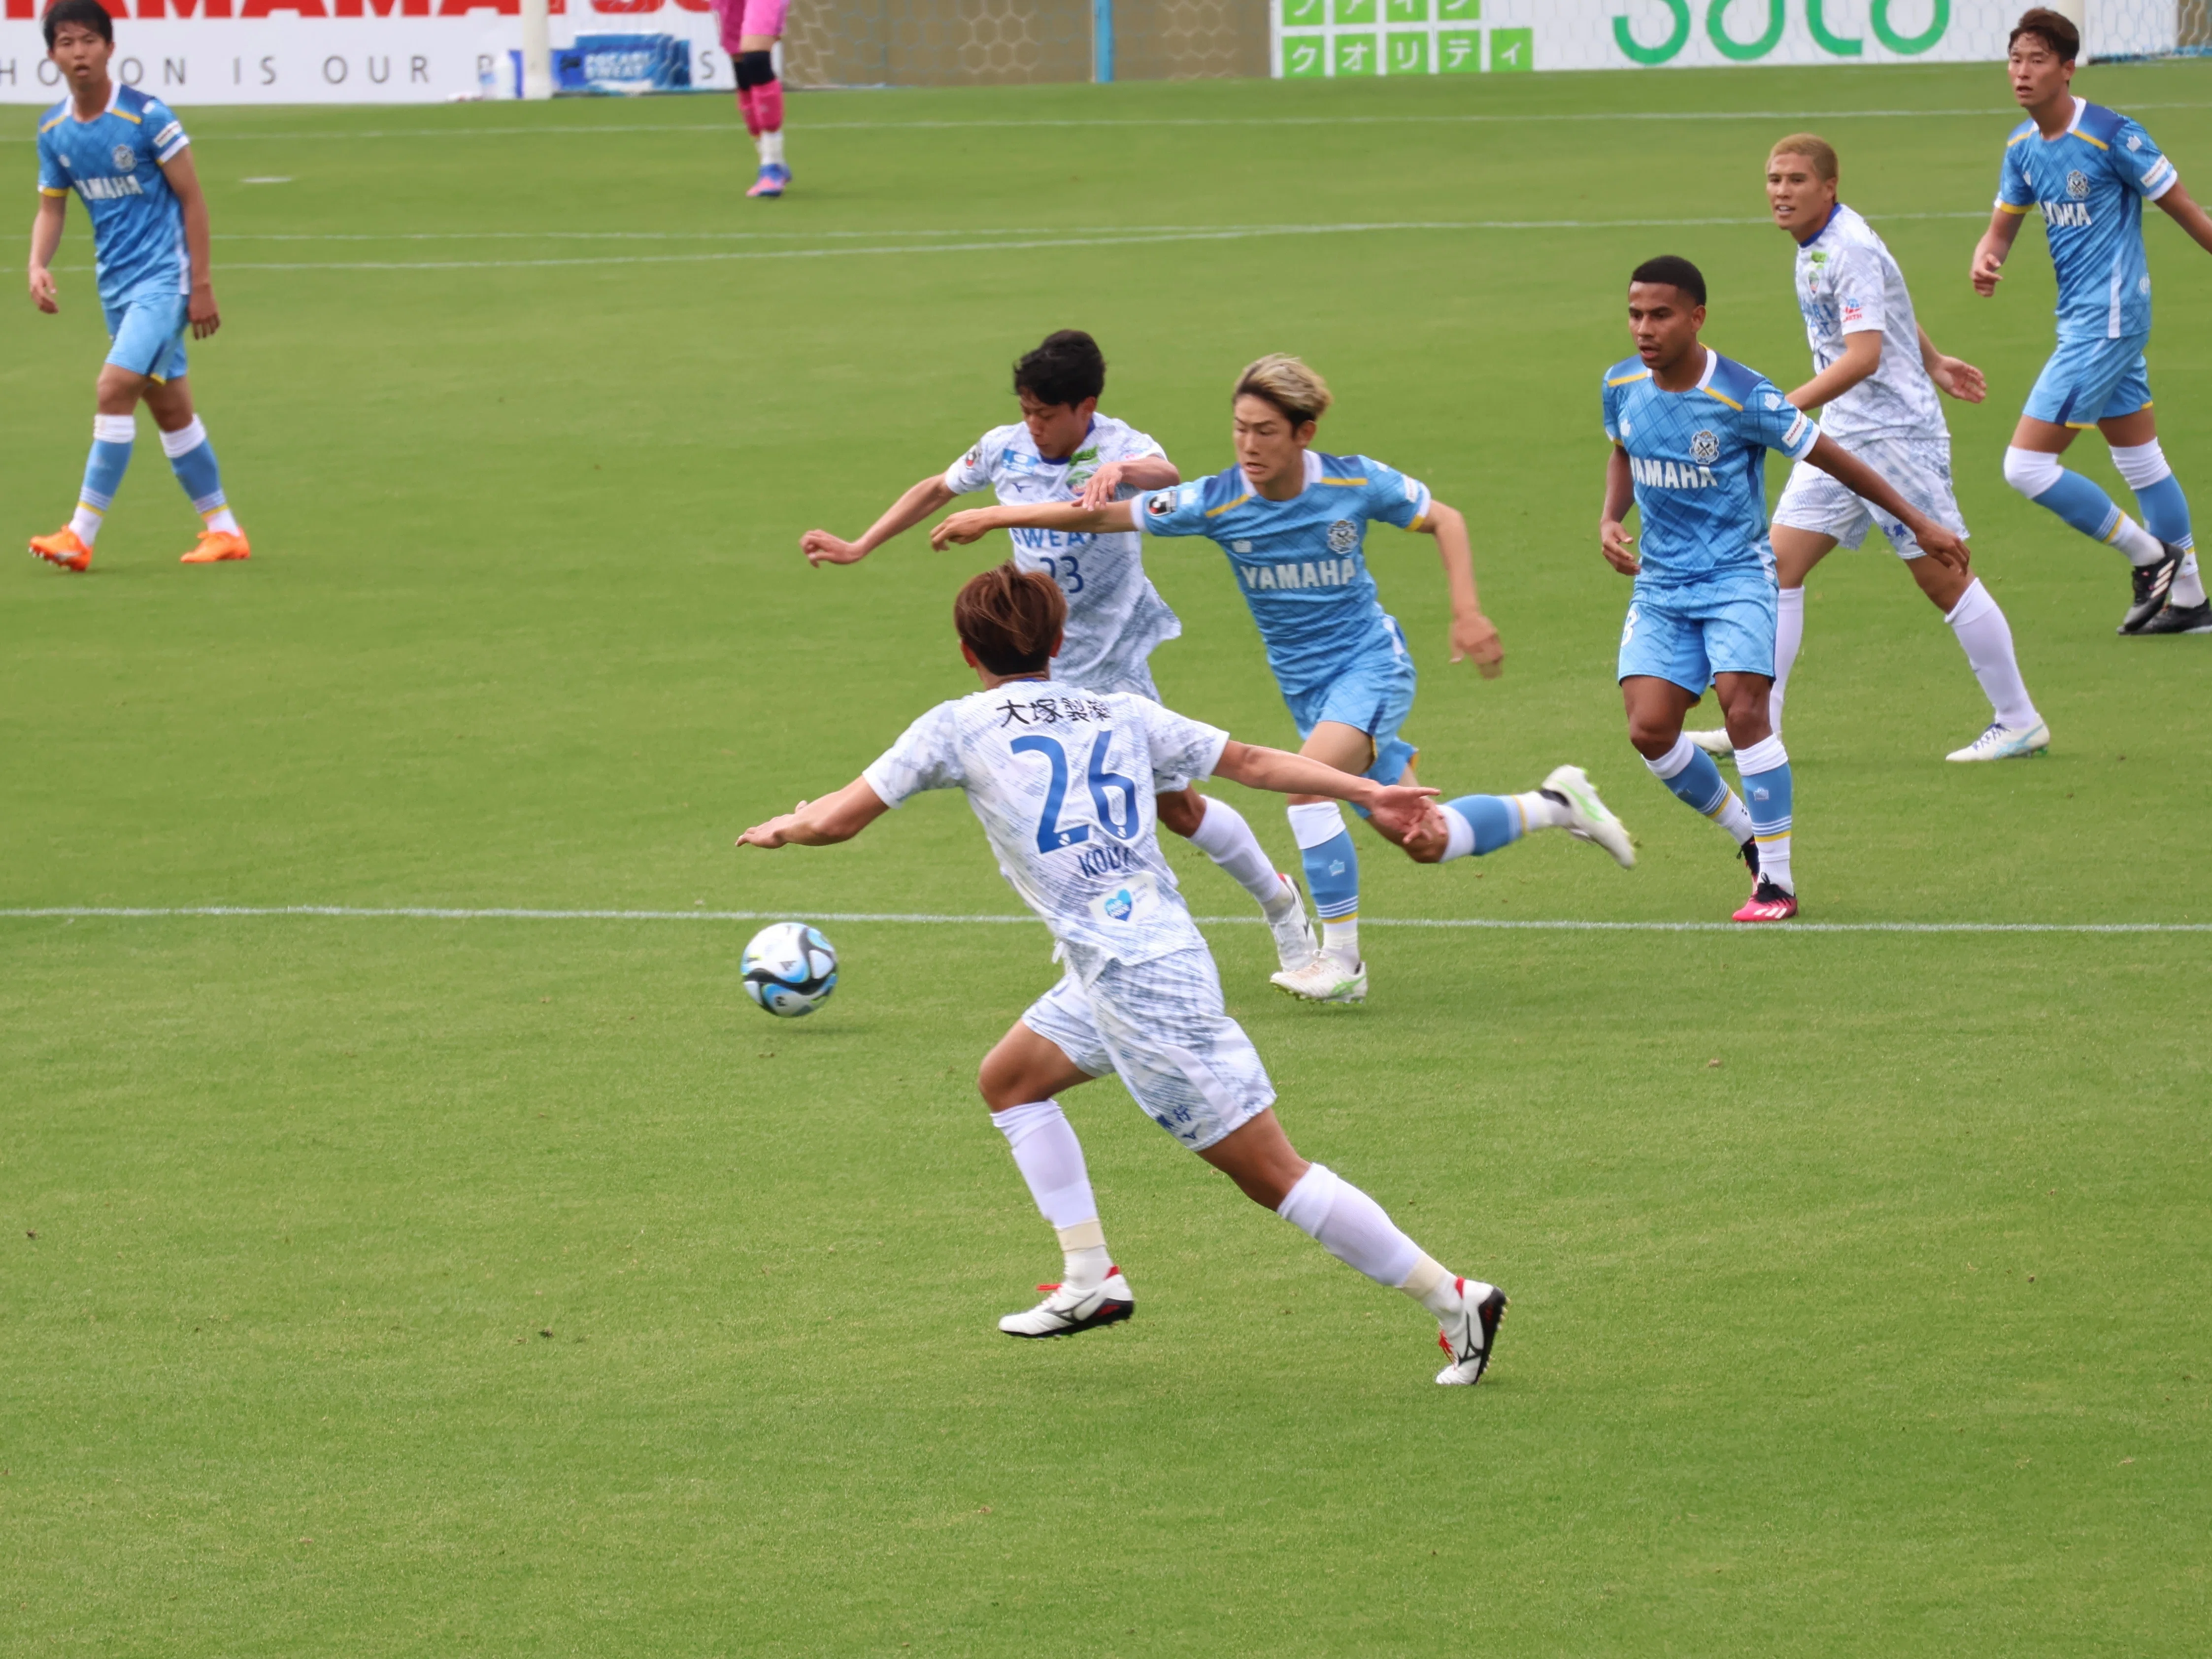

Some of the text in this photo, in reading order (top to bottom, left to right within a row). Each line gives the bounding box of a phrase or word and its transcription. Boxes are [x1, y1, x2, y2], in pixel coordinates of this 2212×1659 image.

[233, 56, 277, 85] IS
[323, 55, 431, 84] OUR
[1292, 40, 1522, 73] クオリティ
[1010, 730, 1139, 854] 26
